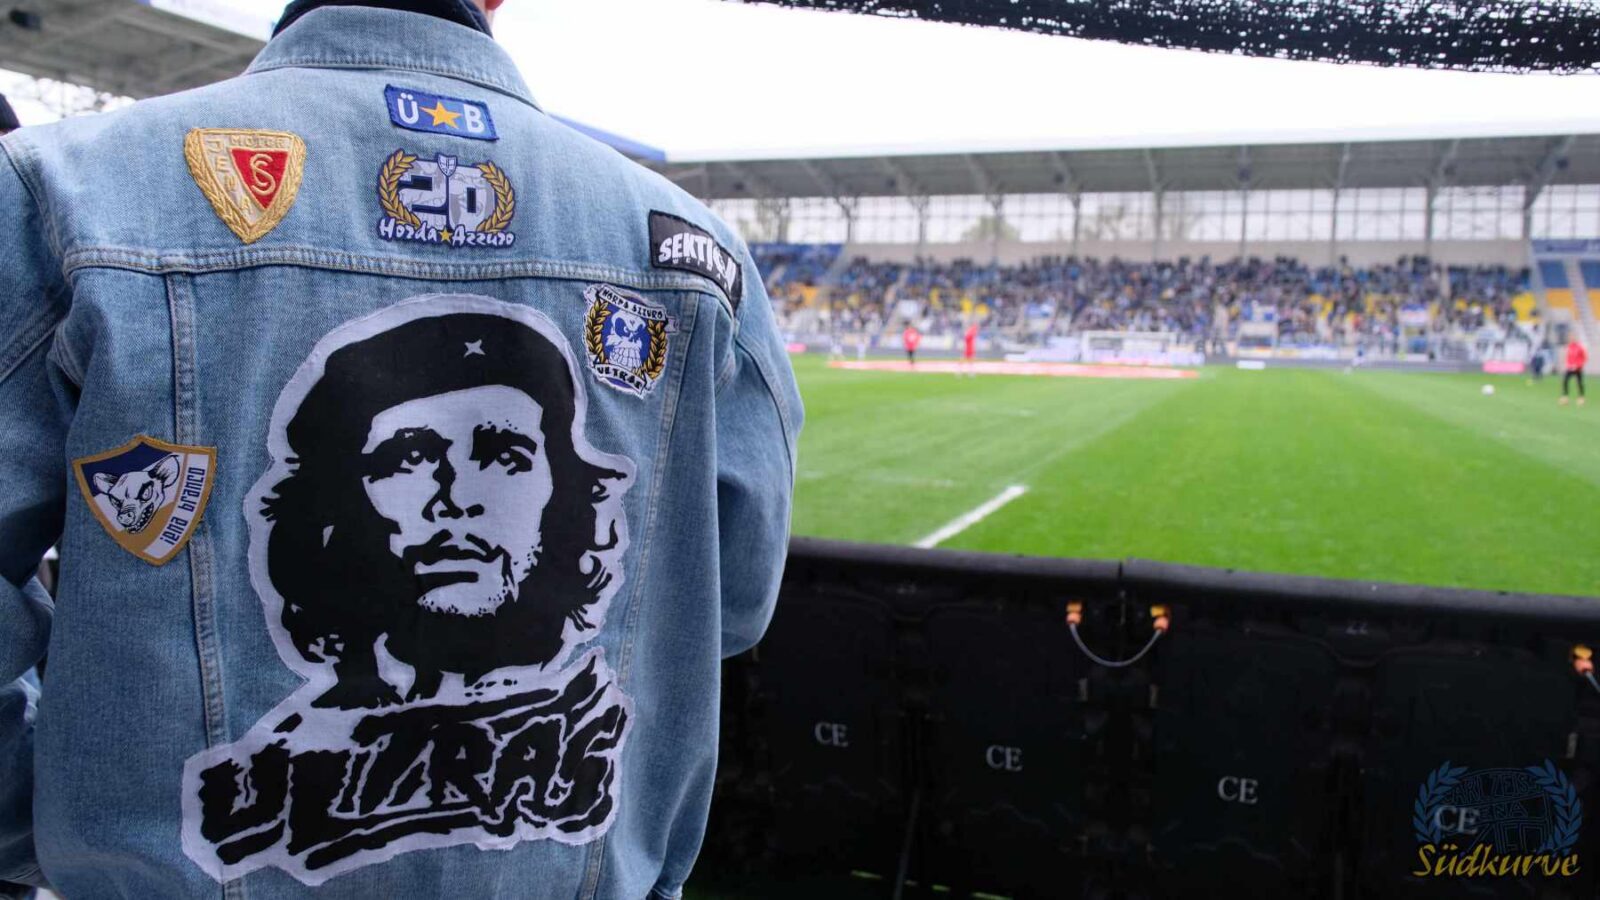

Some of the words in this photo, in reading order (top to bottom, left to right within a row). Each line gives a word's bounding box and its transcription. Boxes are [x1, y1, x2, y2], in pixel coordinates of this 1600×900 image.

[397, 92, 420, 125] Ü
[463, 103, 485, 133] B
[398, 158, 496, 232] 20
[379, 217, 438, 242] Horda
[596, 366, 642, 389] ULTRAS
[178, 466, 206, 513] branco
[813, 721, 850, 748] CE
[198, 656, 628, 868] ULTRAS
[985, 744, 1024, 773] CE
[1217, 775, 1259, 805] CE
[1433, 804, 1481, 836] CE
